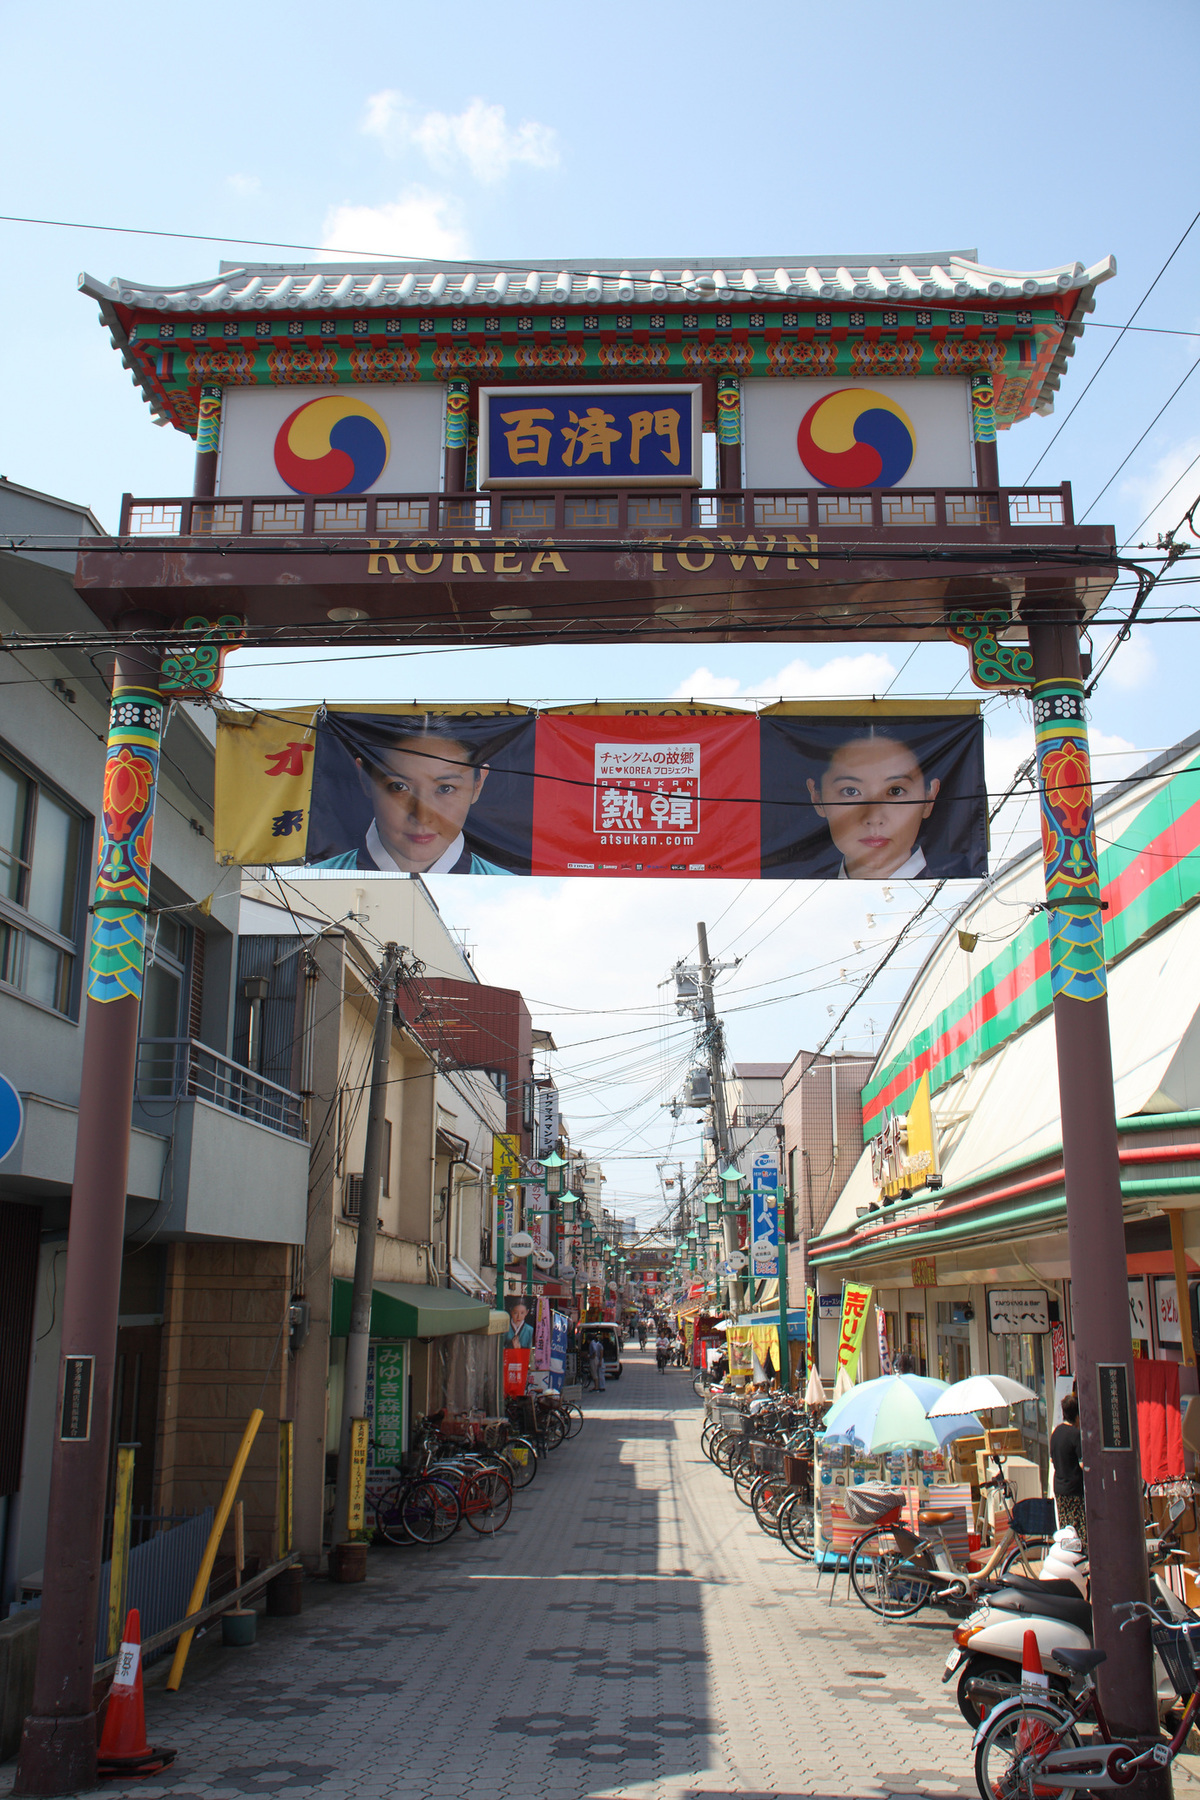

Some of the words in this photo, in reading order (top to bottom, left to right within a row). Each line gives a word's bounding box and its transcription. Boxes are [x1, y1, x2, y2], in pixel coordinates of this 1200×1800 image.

[367, 536, 569, 576] KOREA
[644, 533, 820, 573] TOWN
[600, 751, 694, 765] チャングムの故郷
[600, 766, 614, 775] WE
[623, 766, 652, 775] KOREA
[653, 766, 694, 775] プロジェクト
[600, 834, 694, 846] atsukan.com
[377, 1348, 401, 1463] みゆき森整骨院
